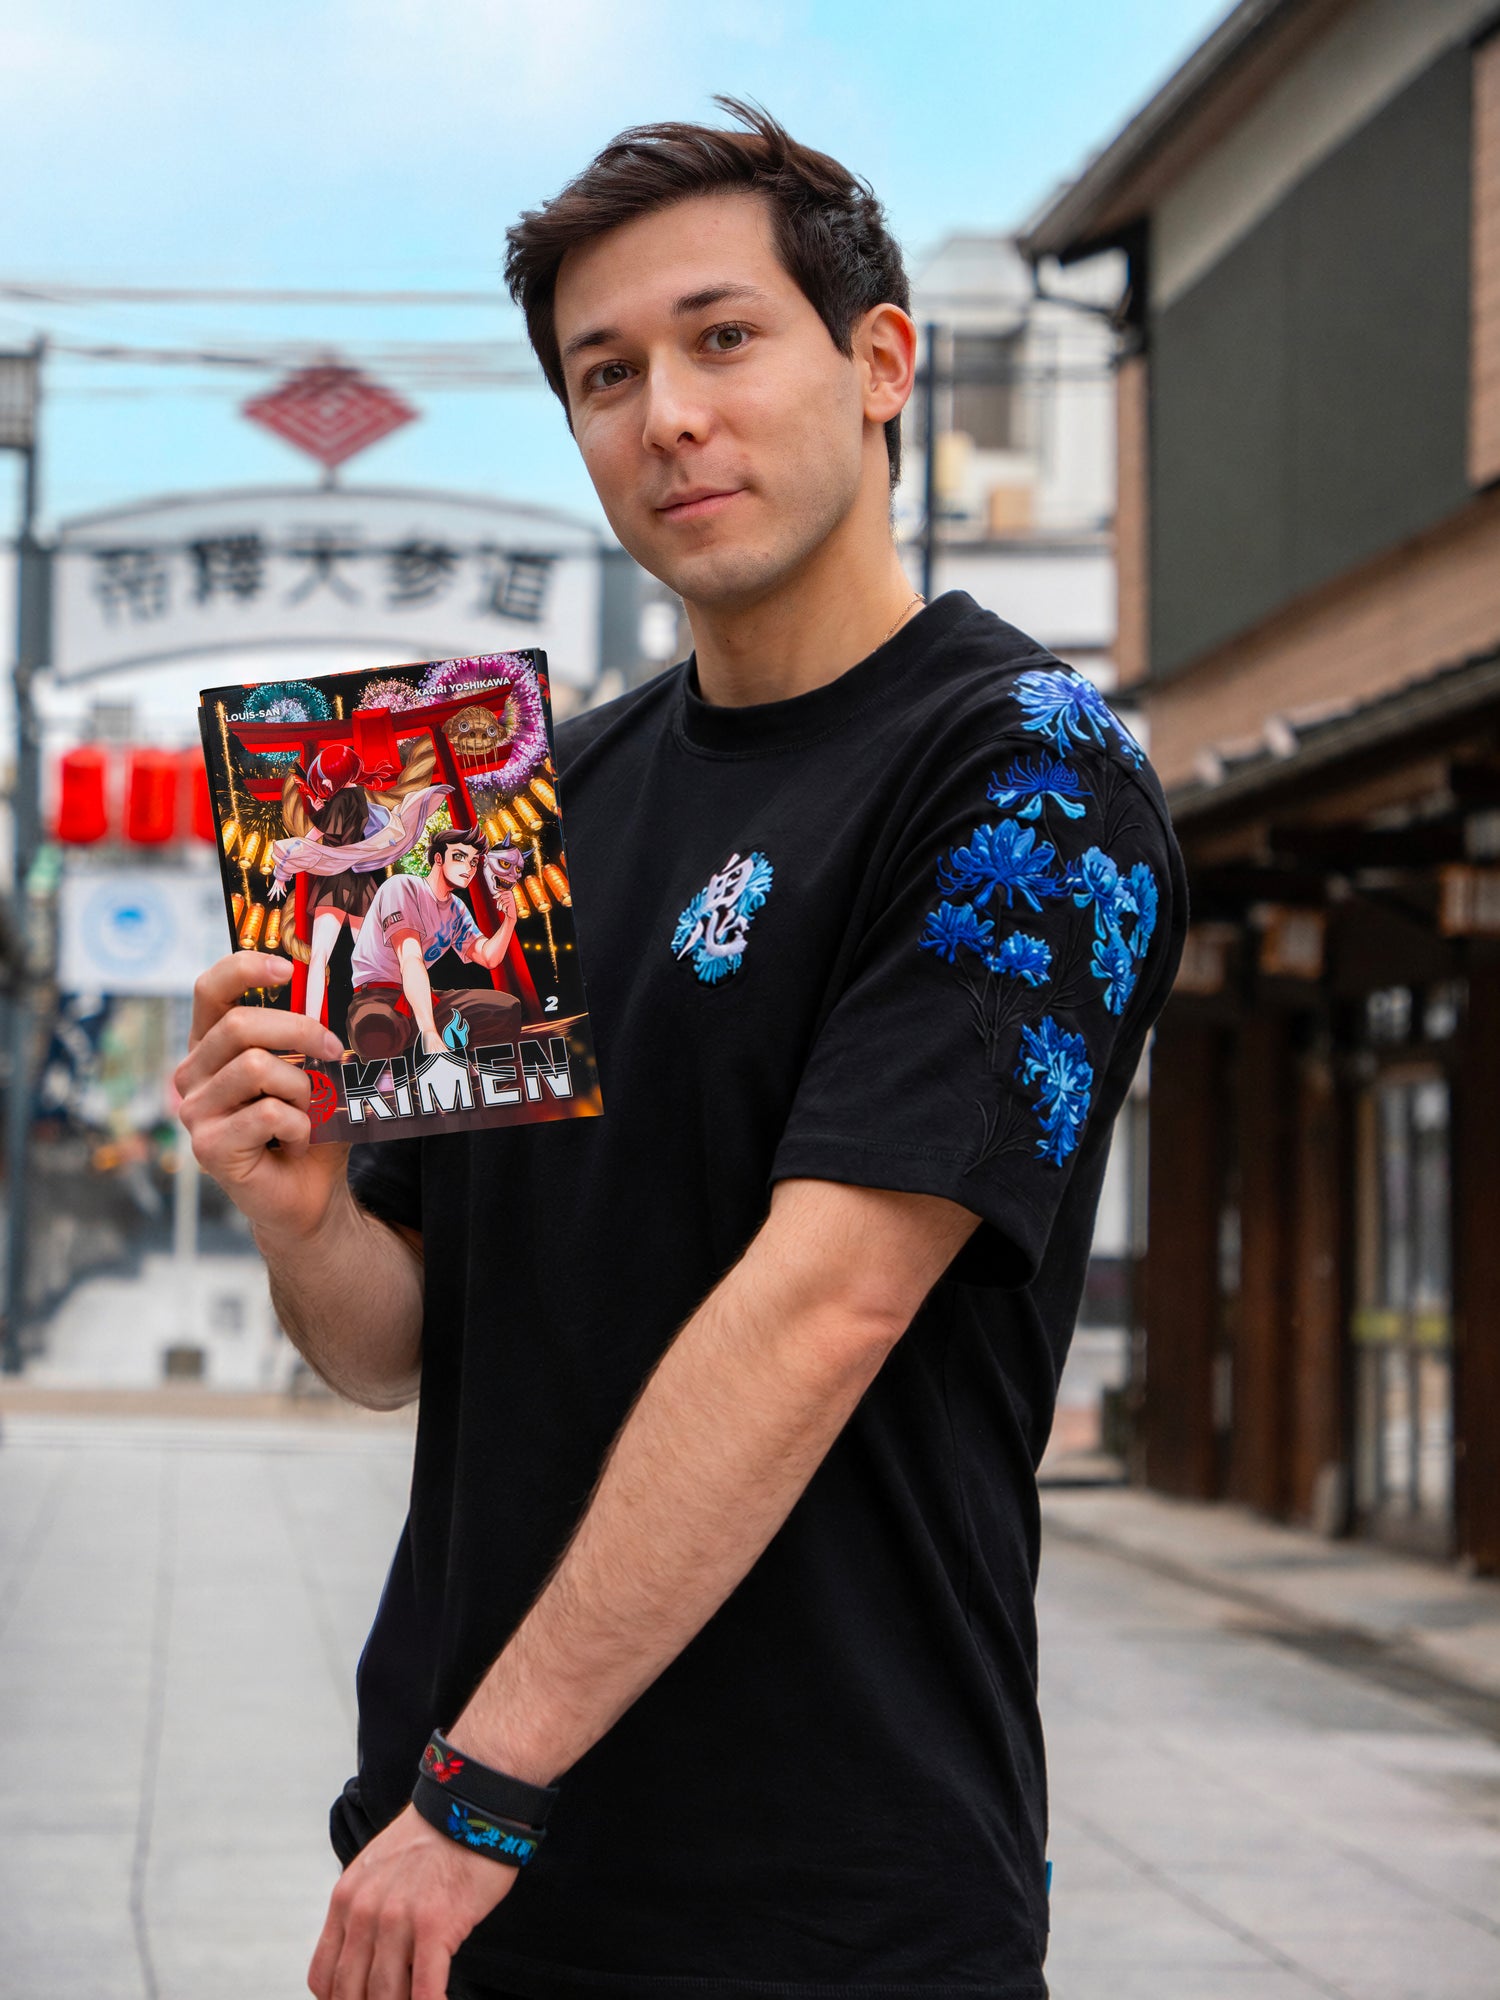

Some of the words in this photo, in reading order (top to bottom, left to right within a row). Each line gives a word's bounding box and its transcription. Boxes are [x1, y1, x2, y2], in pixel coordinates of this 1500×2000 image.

[415, 685, 447, 698] KAORI
[449, 677, 512, 695] YOSHIKAWA
[225, 708, 281, 722] LOUIS-SAN
[544, 996, 559, 1011] 2
[341, 1031, 573, 1124] KIMEN
